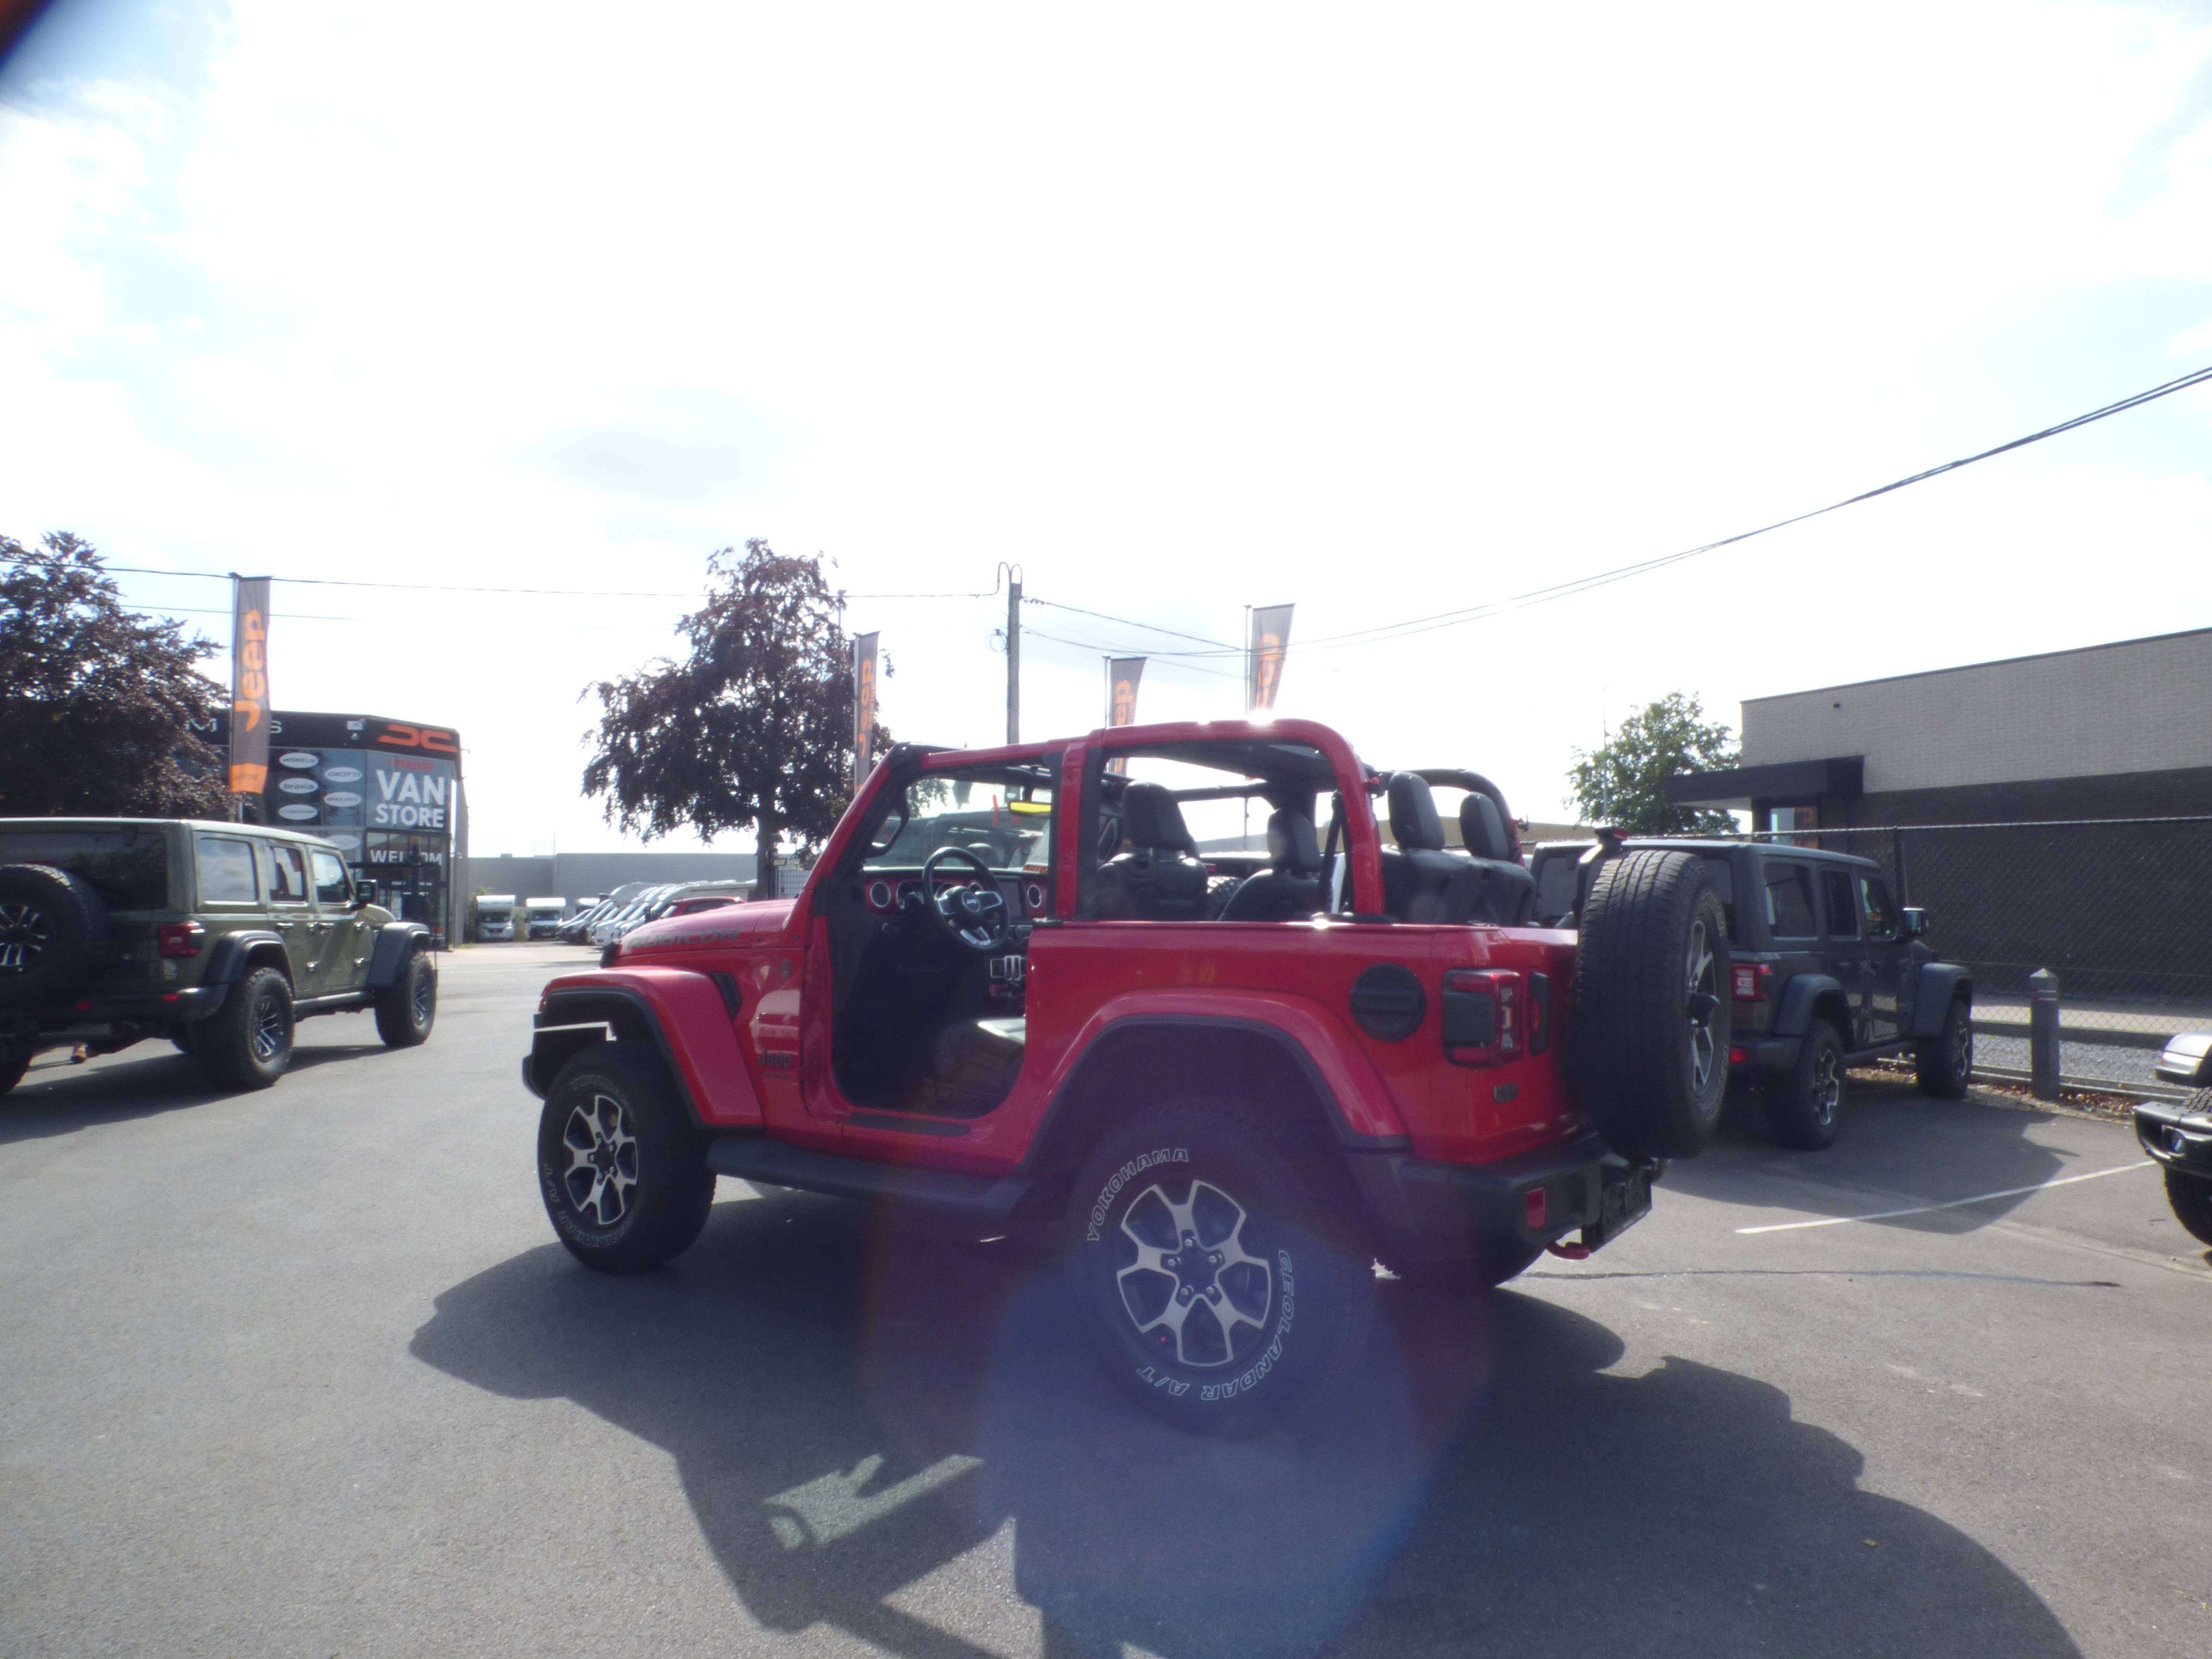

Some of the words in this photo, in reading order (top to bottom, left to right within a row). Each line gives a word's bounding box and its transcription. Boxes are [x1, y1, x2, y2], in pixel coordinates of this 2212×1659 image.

[234, 609, 265, 733] Jeep
[375, 804, 445, 828] STORE
[377, 769, 445, 805] VAN
[1087, 1148, 1189, 1241] YOKOHAMA
[1201, 1250, 1295, 1400] GEOLANDAR
[1136, 1367, 1190, 1396] A/T
